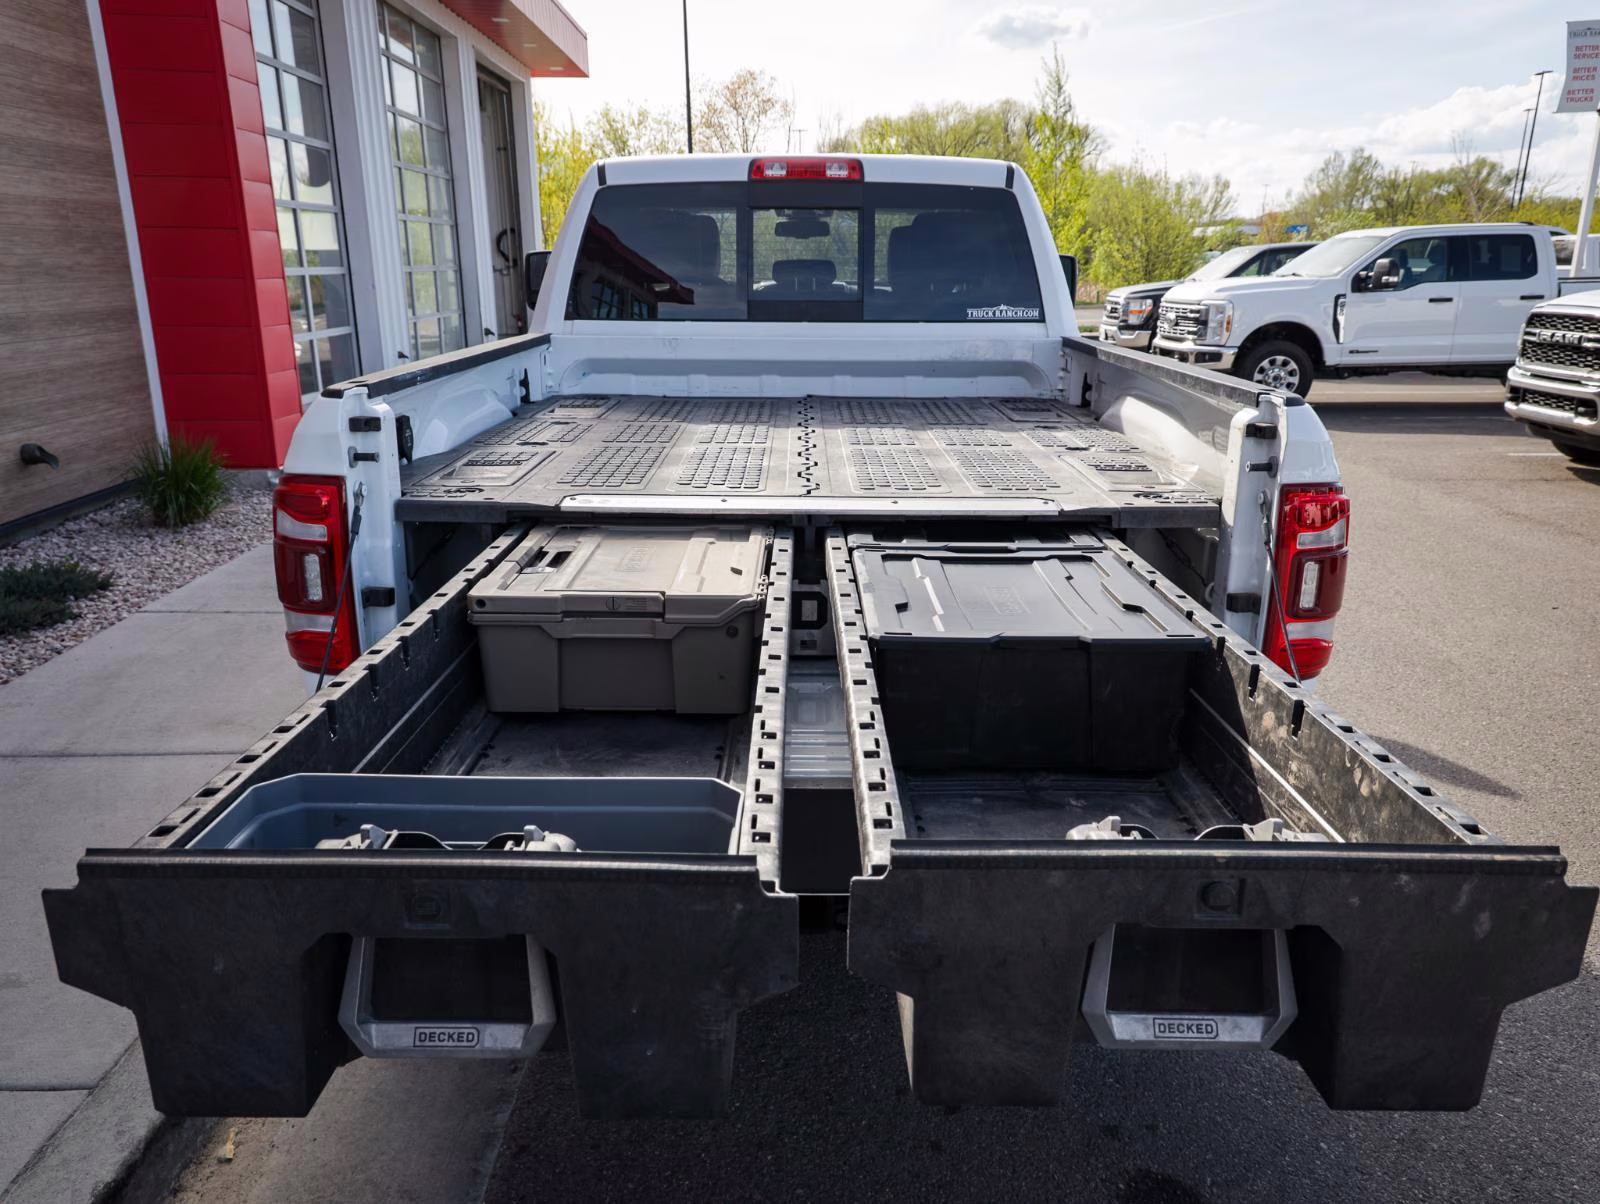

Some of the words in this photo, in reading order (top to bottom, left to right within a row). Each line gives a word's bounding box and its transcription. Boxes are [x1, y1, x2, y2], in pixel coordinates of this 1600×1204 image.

[1567, 88, 1594, 96] BETTER
[967, 310, 994, 318] TRUCK
[1539, 331, 1581, 345] RAM
[1158, 1022, 1214, 1035] DECKED
[418, 1031, 475, 1043] DECKED
